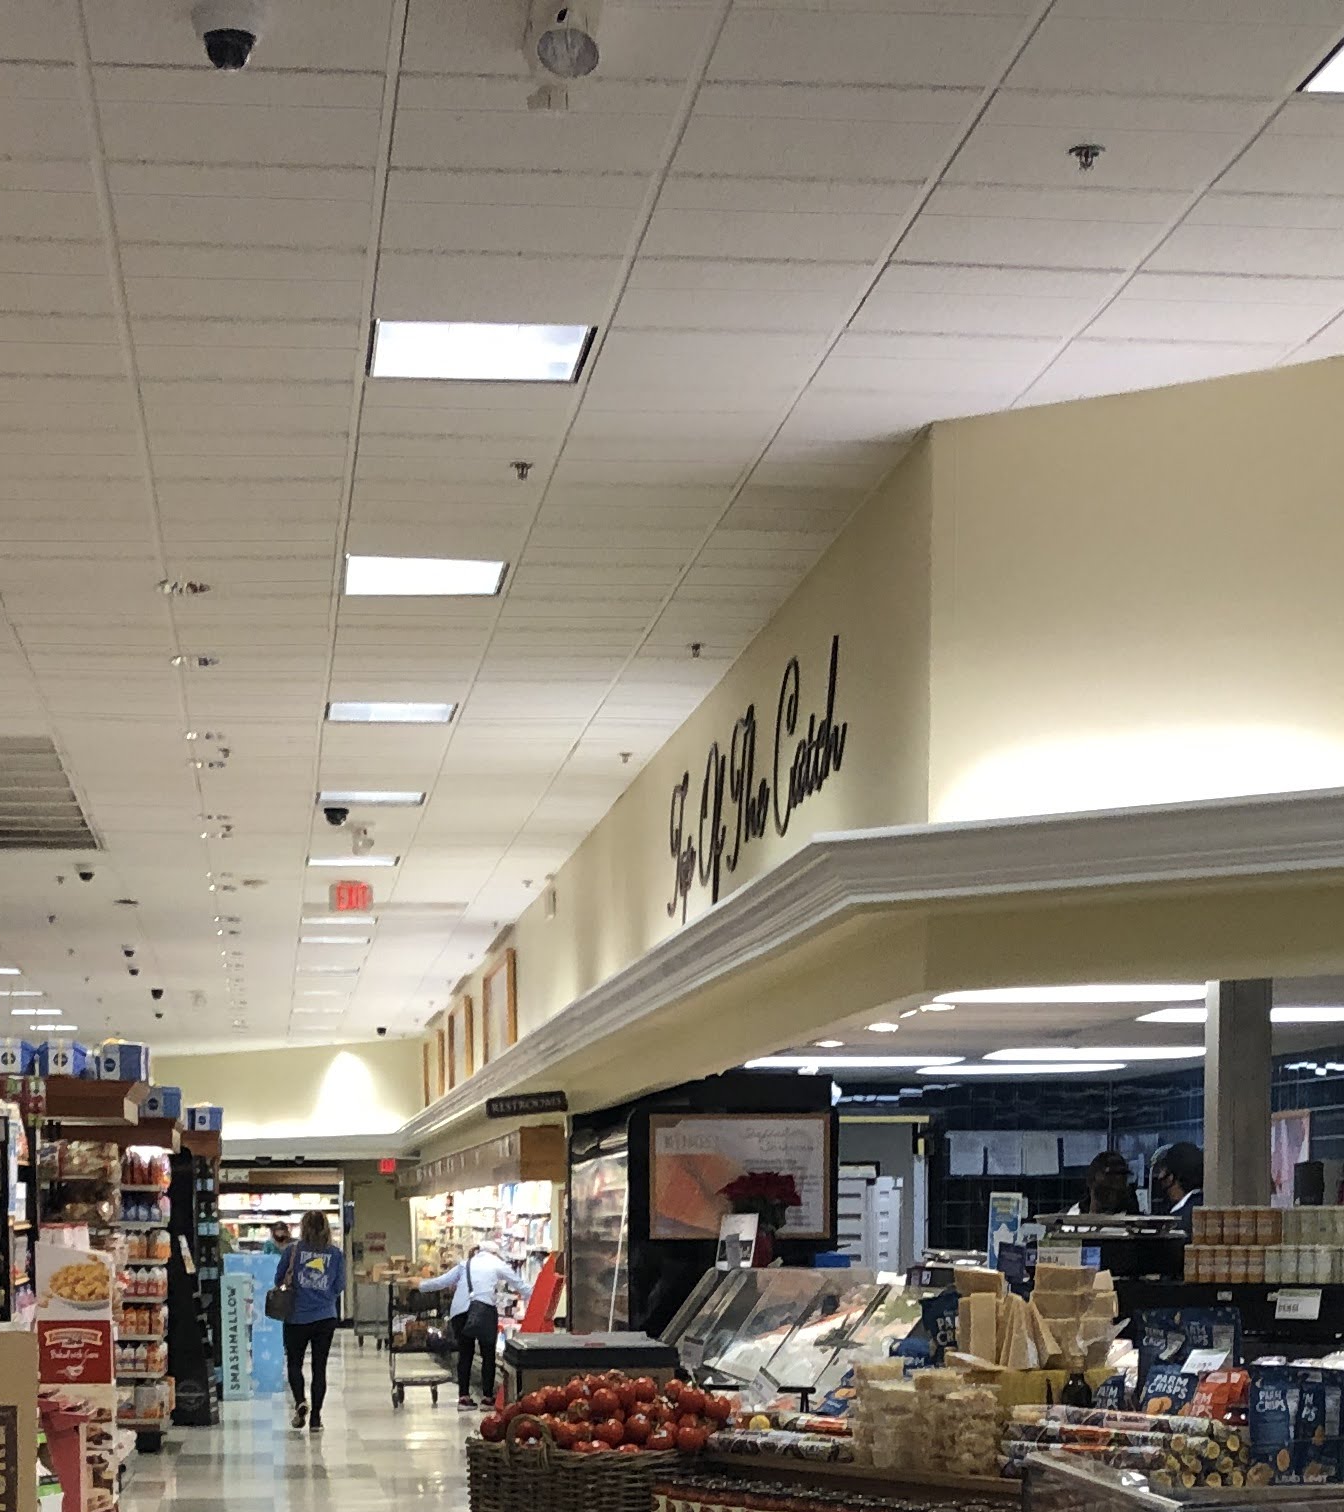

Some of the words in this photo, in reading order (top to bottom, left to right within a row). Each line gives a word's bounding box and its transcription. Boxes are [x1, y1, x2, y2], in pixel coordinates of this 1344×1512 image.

[936, 1316, 956, 1329] PA
[227, 1285, 240, 1390] SMASHMALLOW
[1153, 1373, 1189, 1388] PARM
[1147, 1383, 1189, 1400] CRISPS
[1258, 1390, 1283, 1401] PARM
